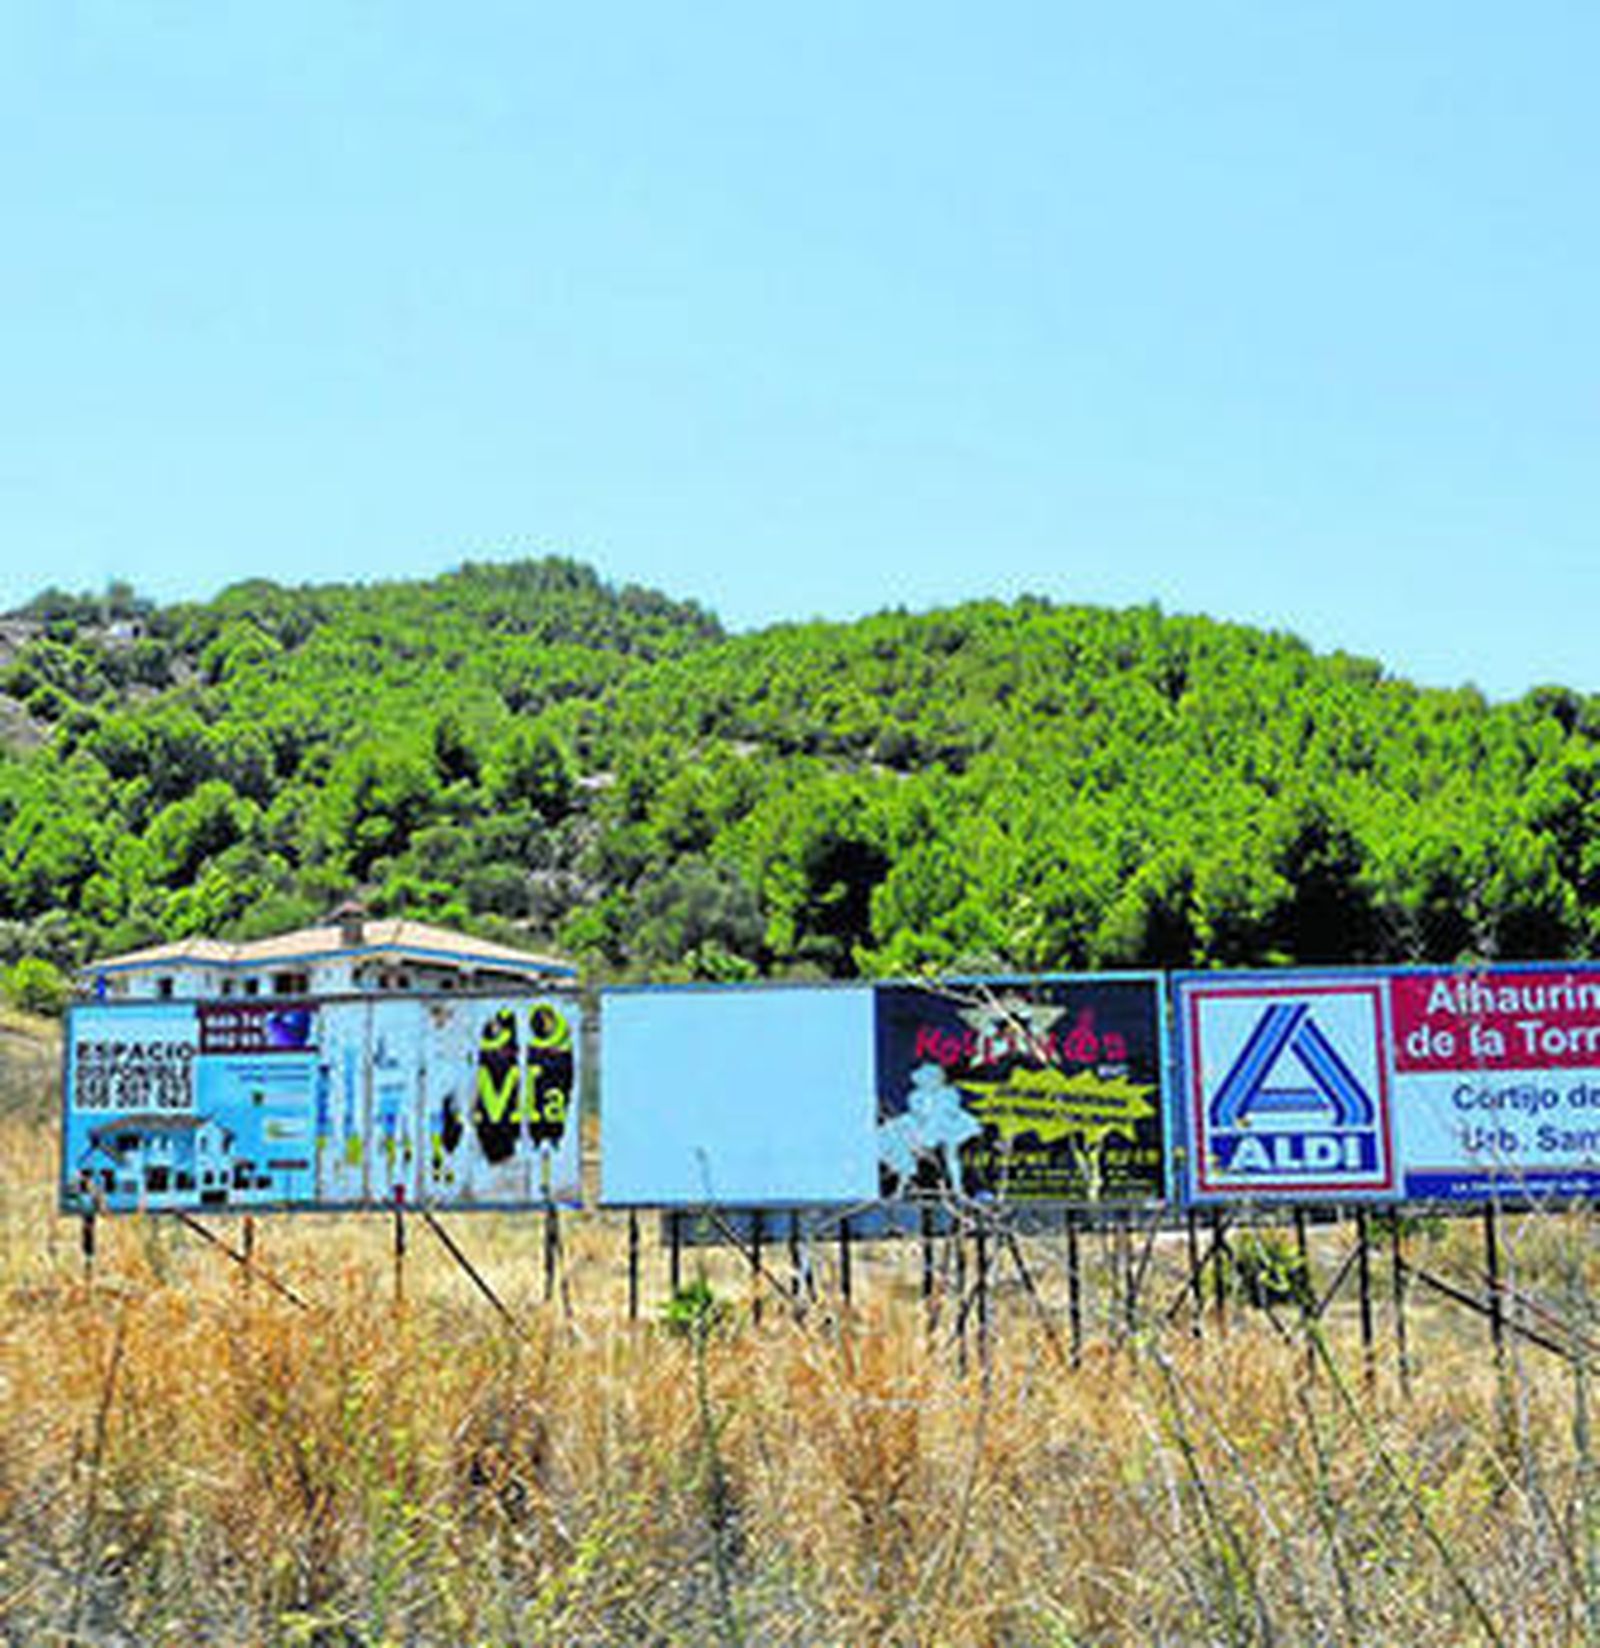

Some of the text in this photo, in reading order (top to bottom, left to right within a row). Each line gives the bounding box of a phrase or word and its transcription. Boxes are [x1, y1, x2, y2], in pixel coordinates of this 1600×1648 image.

[77, 1041, 195, 1061] ESPACIO
[1407, 1024, 1454, 1057] de
[1453, 1084, 1560, 1116] Cortijo
[1231, 1135, 1362, 1170] ALDI
